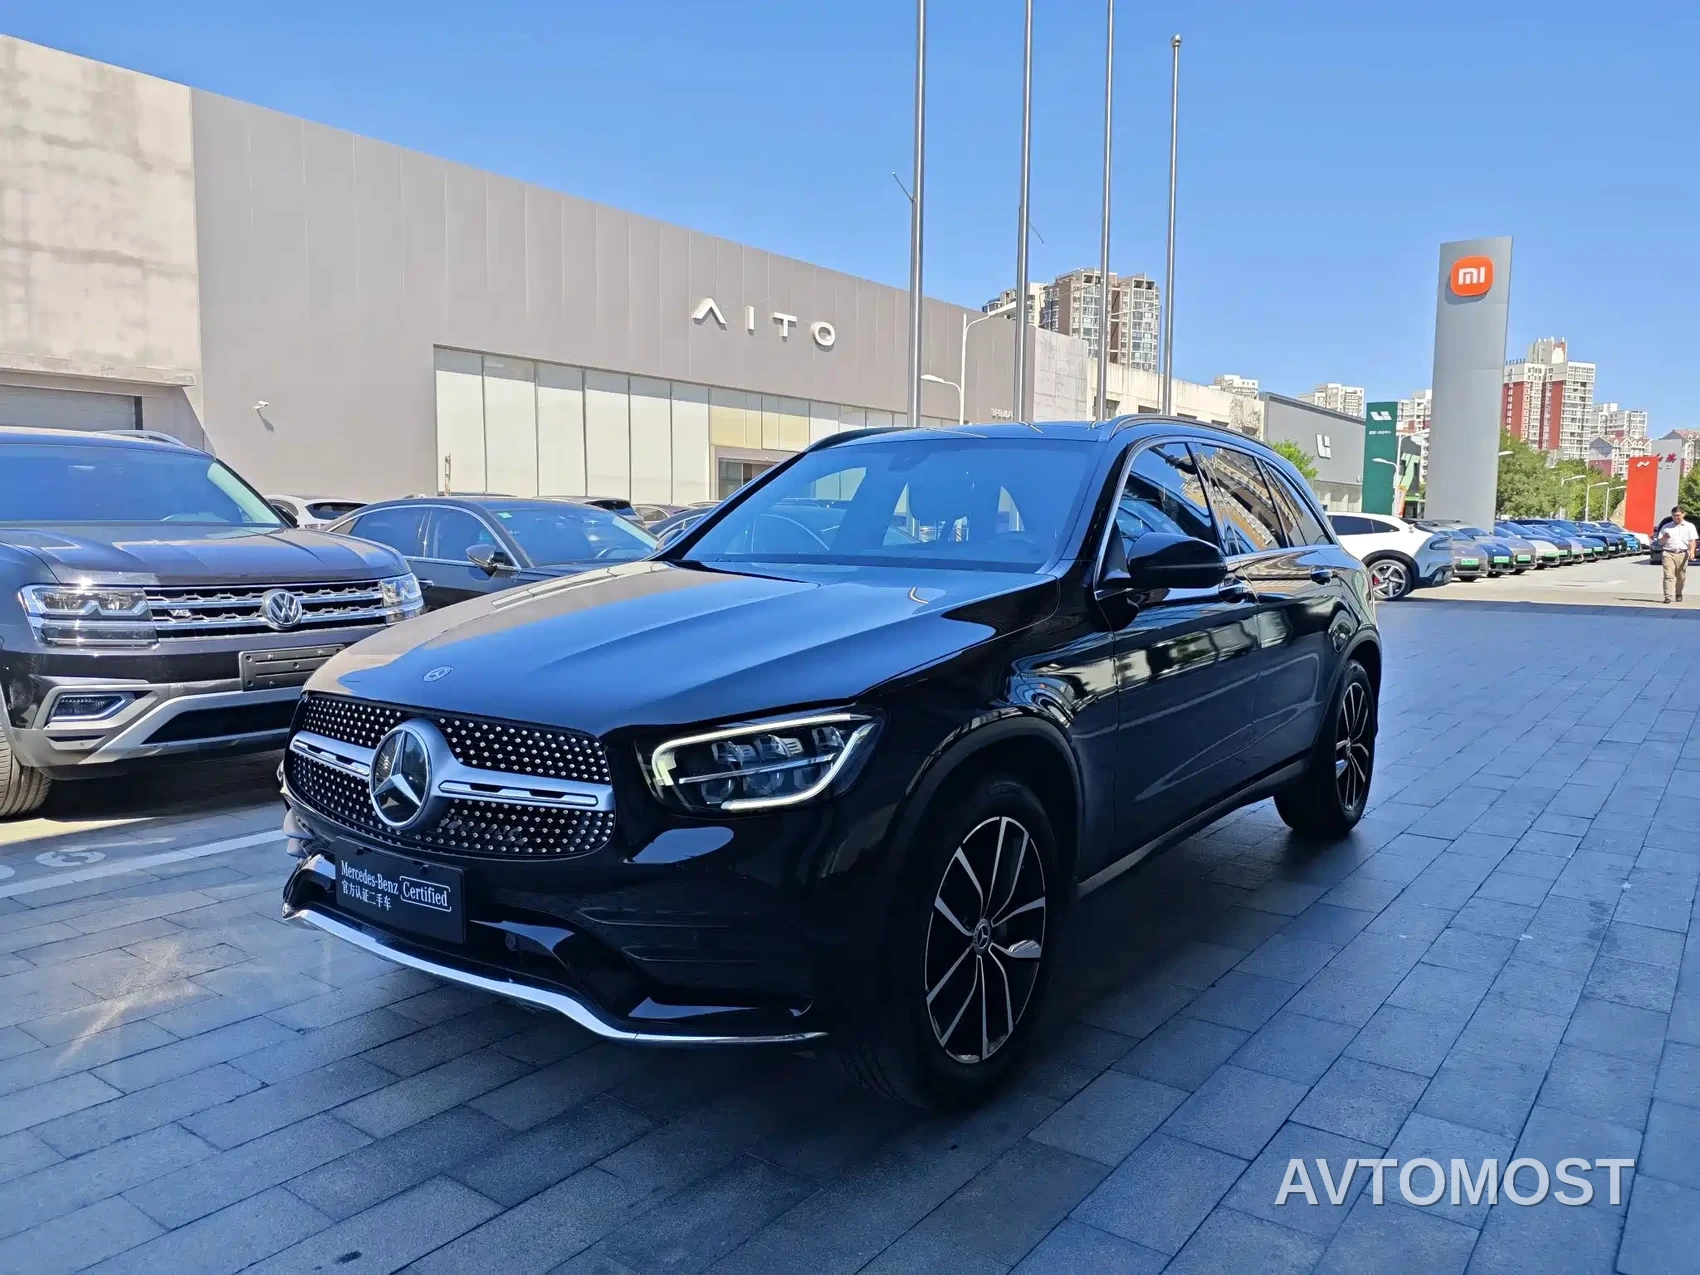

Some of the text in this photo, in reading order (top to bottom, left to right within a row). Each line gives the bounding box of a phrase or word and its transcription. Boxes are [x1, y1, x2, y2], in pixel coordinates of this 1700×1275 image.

[692, 297, 837, 348] AITO
[341, 860, 448, 907] Mercedes-Benz Certified
[342, 880, 391, 911] 官方认证二手车
